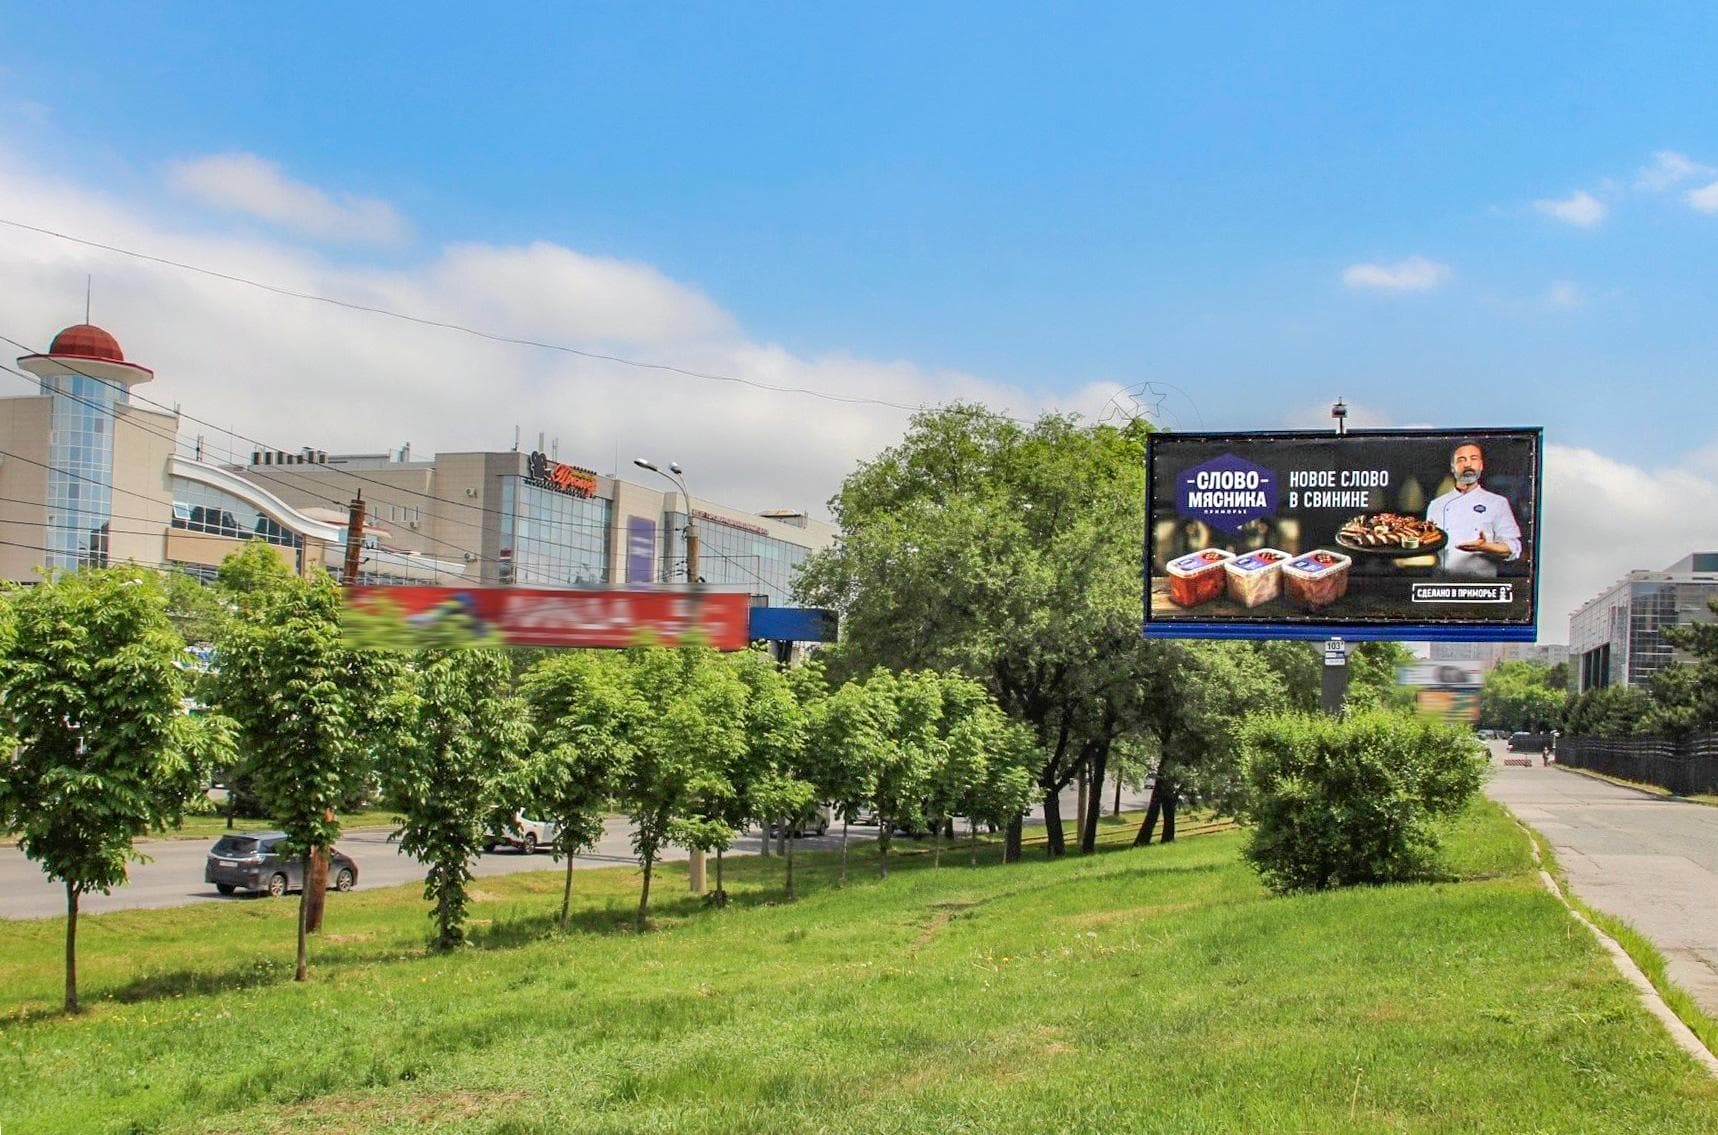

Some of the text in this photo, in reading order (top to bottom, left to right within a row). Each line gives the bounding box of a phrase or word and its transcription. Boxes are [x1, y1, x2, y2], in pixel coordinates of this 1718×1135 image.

[1290, 470, 1389, 487] НОВОЕ СЛОВО
[1188, 491, 1267, 508] МЯСНИКА
[1289, 491, 1369, 508] В СВИНИНЕ
[1417, 588, 1497, 598] СДЕЛАНО В ПРИМОРЬЕ
